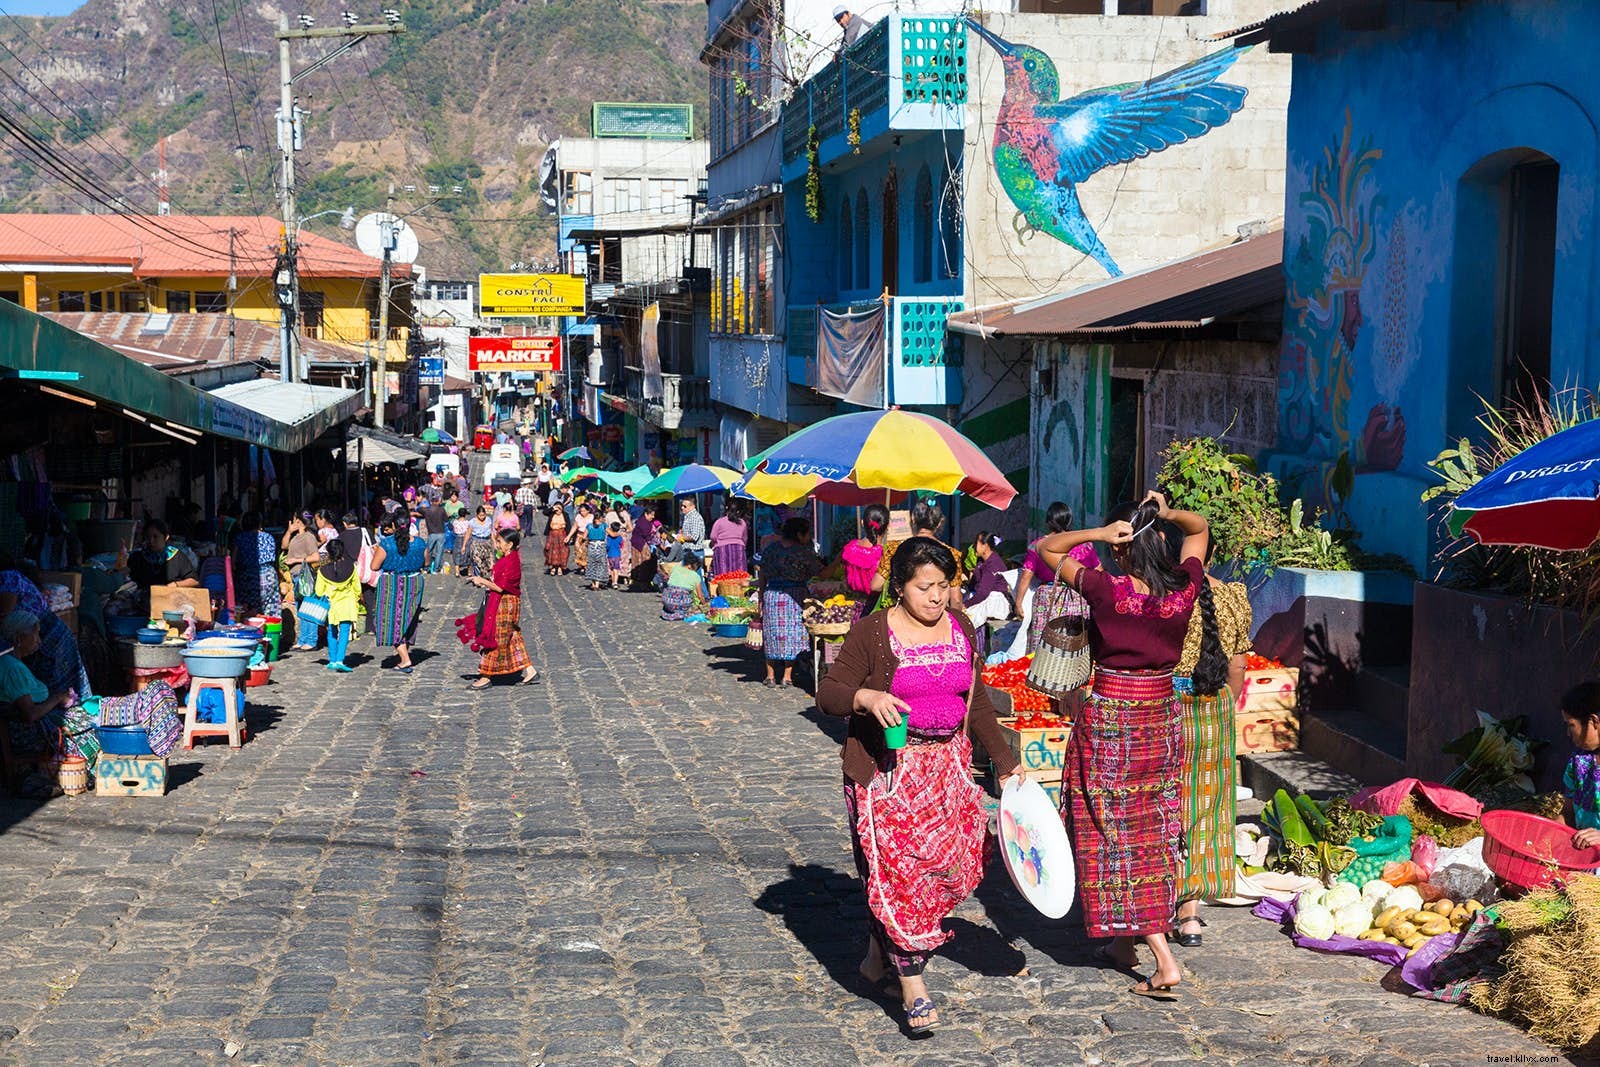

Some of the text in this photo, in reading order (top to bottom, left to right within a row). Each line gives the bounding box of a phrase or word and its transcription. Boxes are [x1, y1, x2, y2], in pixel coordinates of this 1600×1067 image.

[497, 288, 553, 296] CONSTRU
[476, 350, 554, 362] MARKET
[777, 462, 839, 477] DIRECT
[1504, 458, 1600, 485] DIRECT
